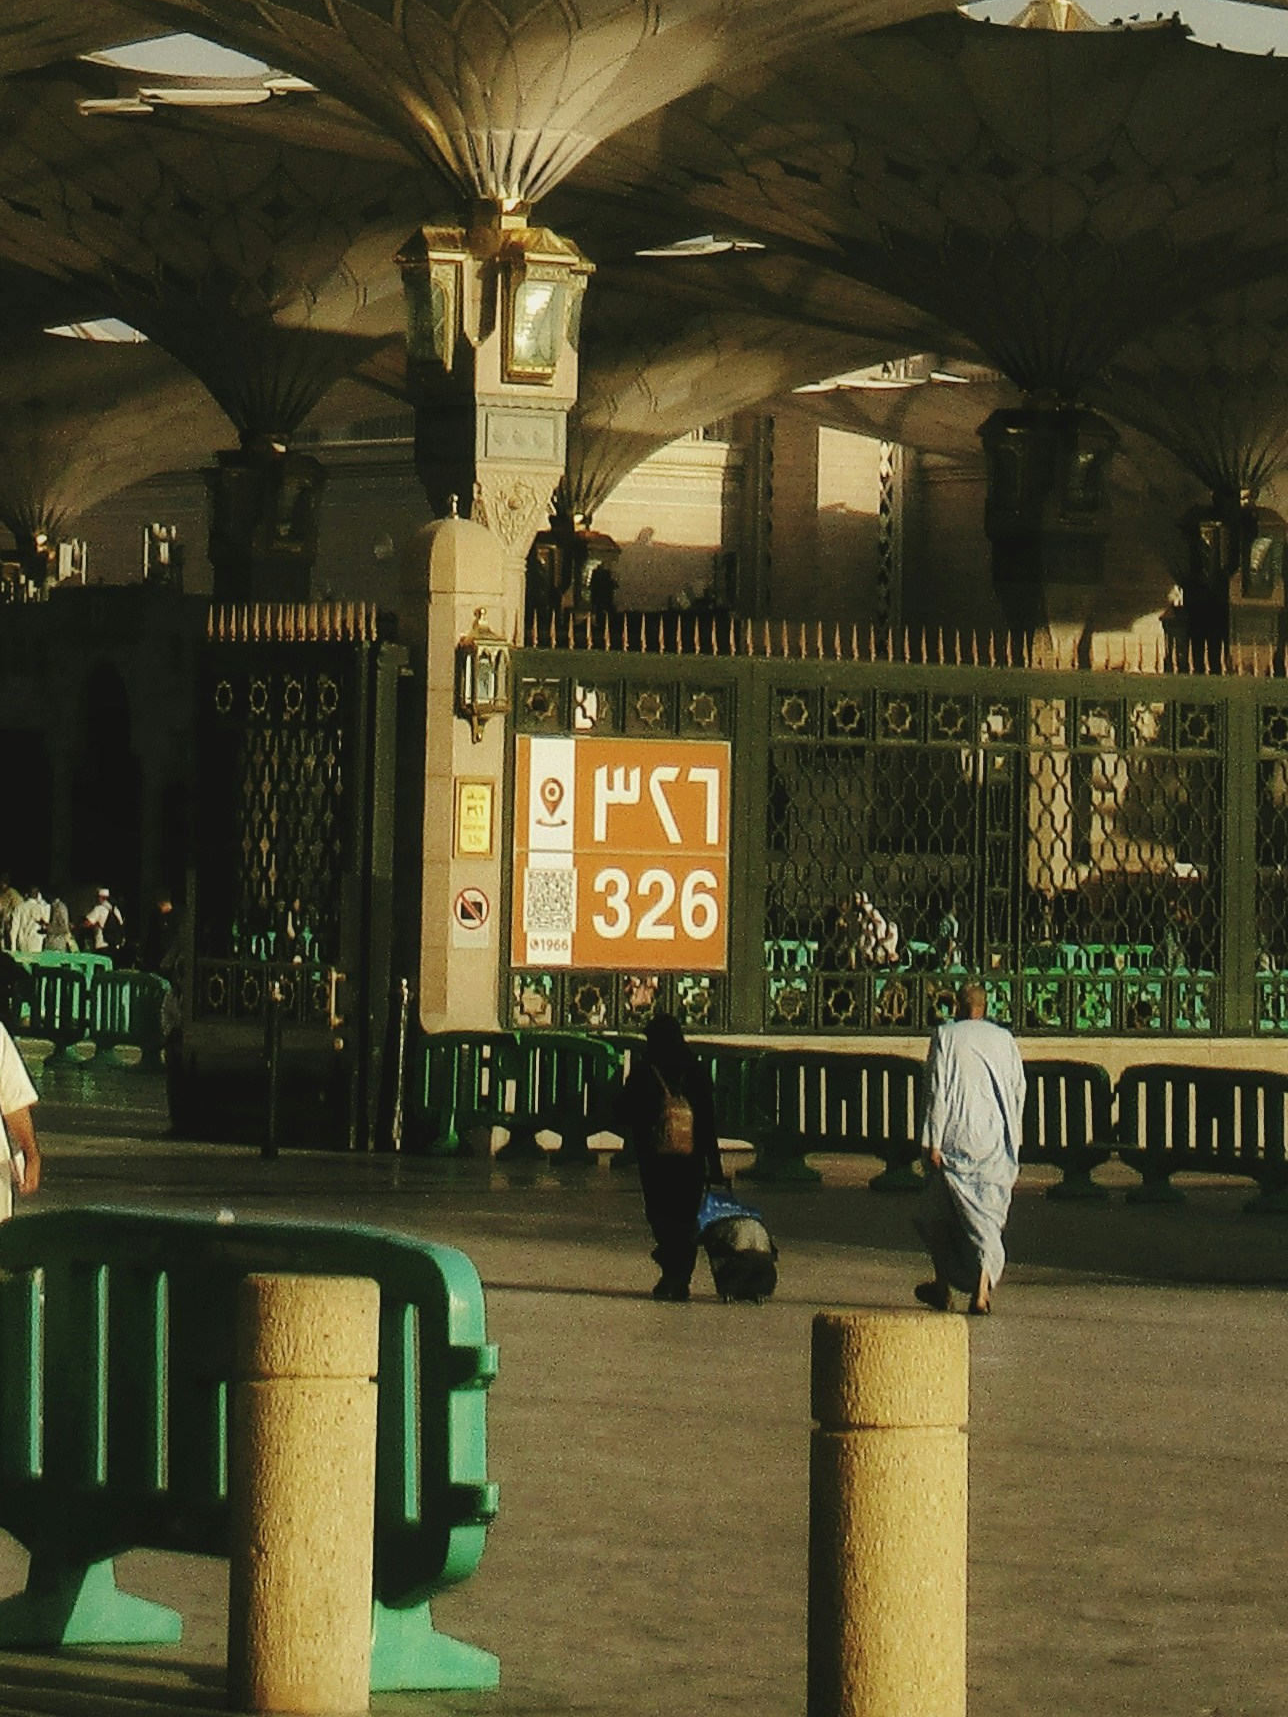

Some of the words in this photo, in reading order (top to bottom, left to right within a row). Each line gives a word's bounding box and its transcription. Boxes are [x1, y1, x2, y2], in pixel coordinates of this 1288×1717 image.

[594, 765, 720, 845] ٣٢٦
[592, 868, 719, 940] 326
[541, 939, 569, 952] 1966
